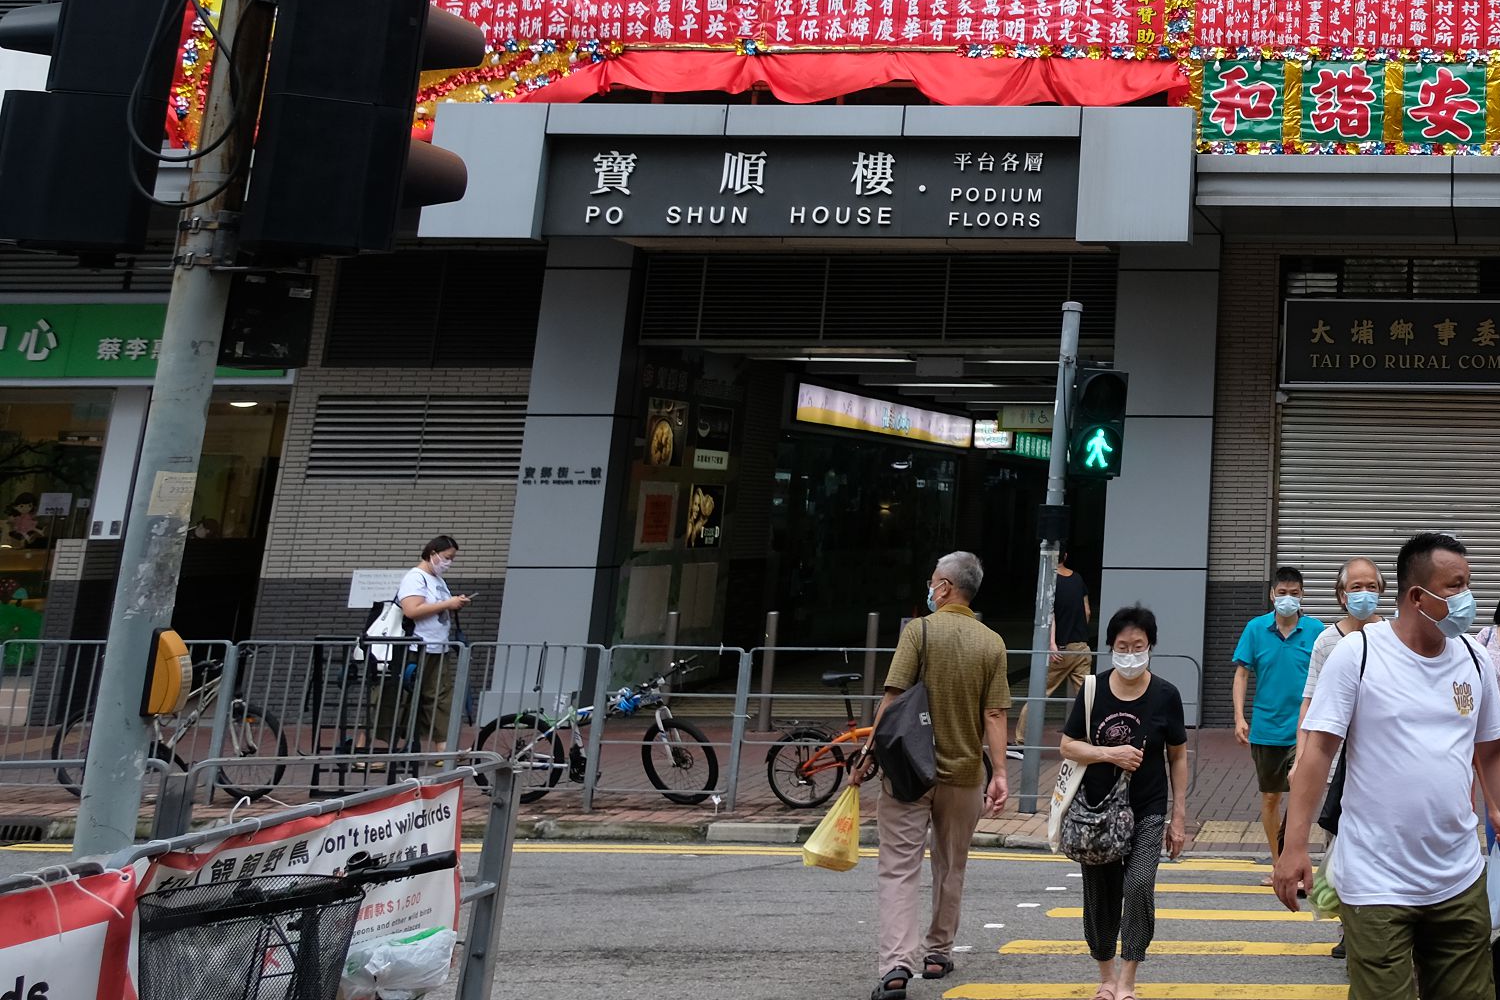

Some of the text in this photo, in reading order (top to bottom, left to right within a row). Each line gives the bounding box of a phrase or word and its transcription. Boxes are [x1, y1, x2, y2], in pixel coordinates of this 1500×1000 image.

[952, 151, 1044, 173] 平台各層
[589, 150, 895, 196] 寶順樓
[950, 187, 1043, 203] PODIUM
[584, 206, 893, 225] PO SHUN HOUSE
[949, 211, 1042, 228] FLOORS
[0, 319, 57, 361] 心
[1310, 354, 1341, 369] TAI
[1350, 354, 1377, 369] PO
[1385, 354, 1451, 370] RURAL
[364, 819, 392, 844] feed
